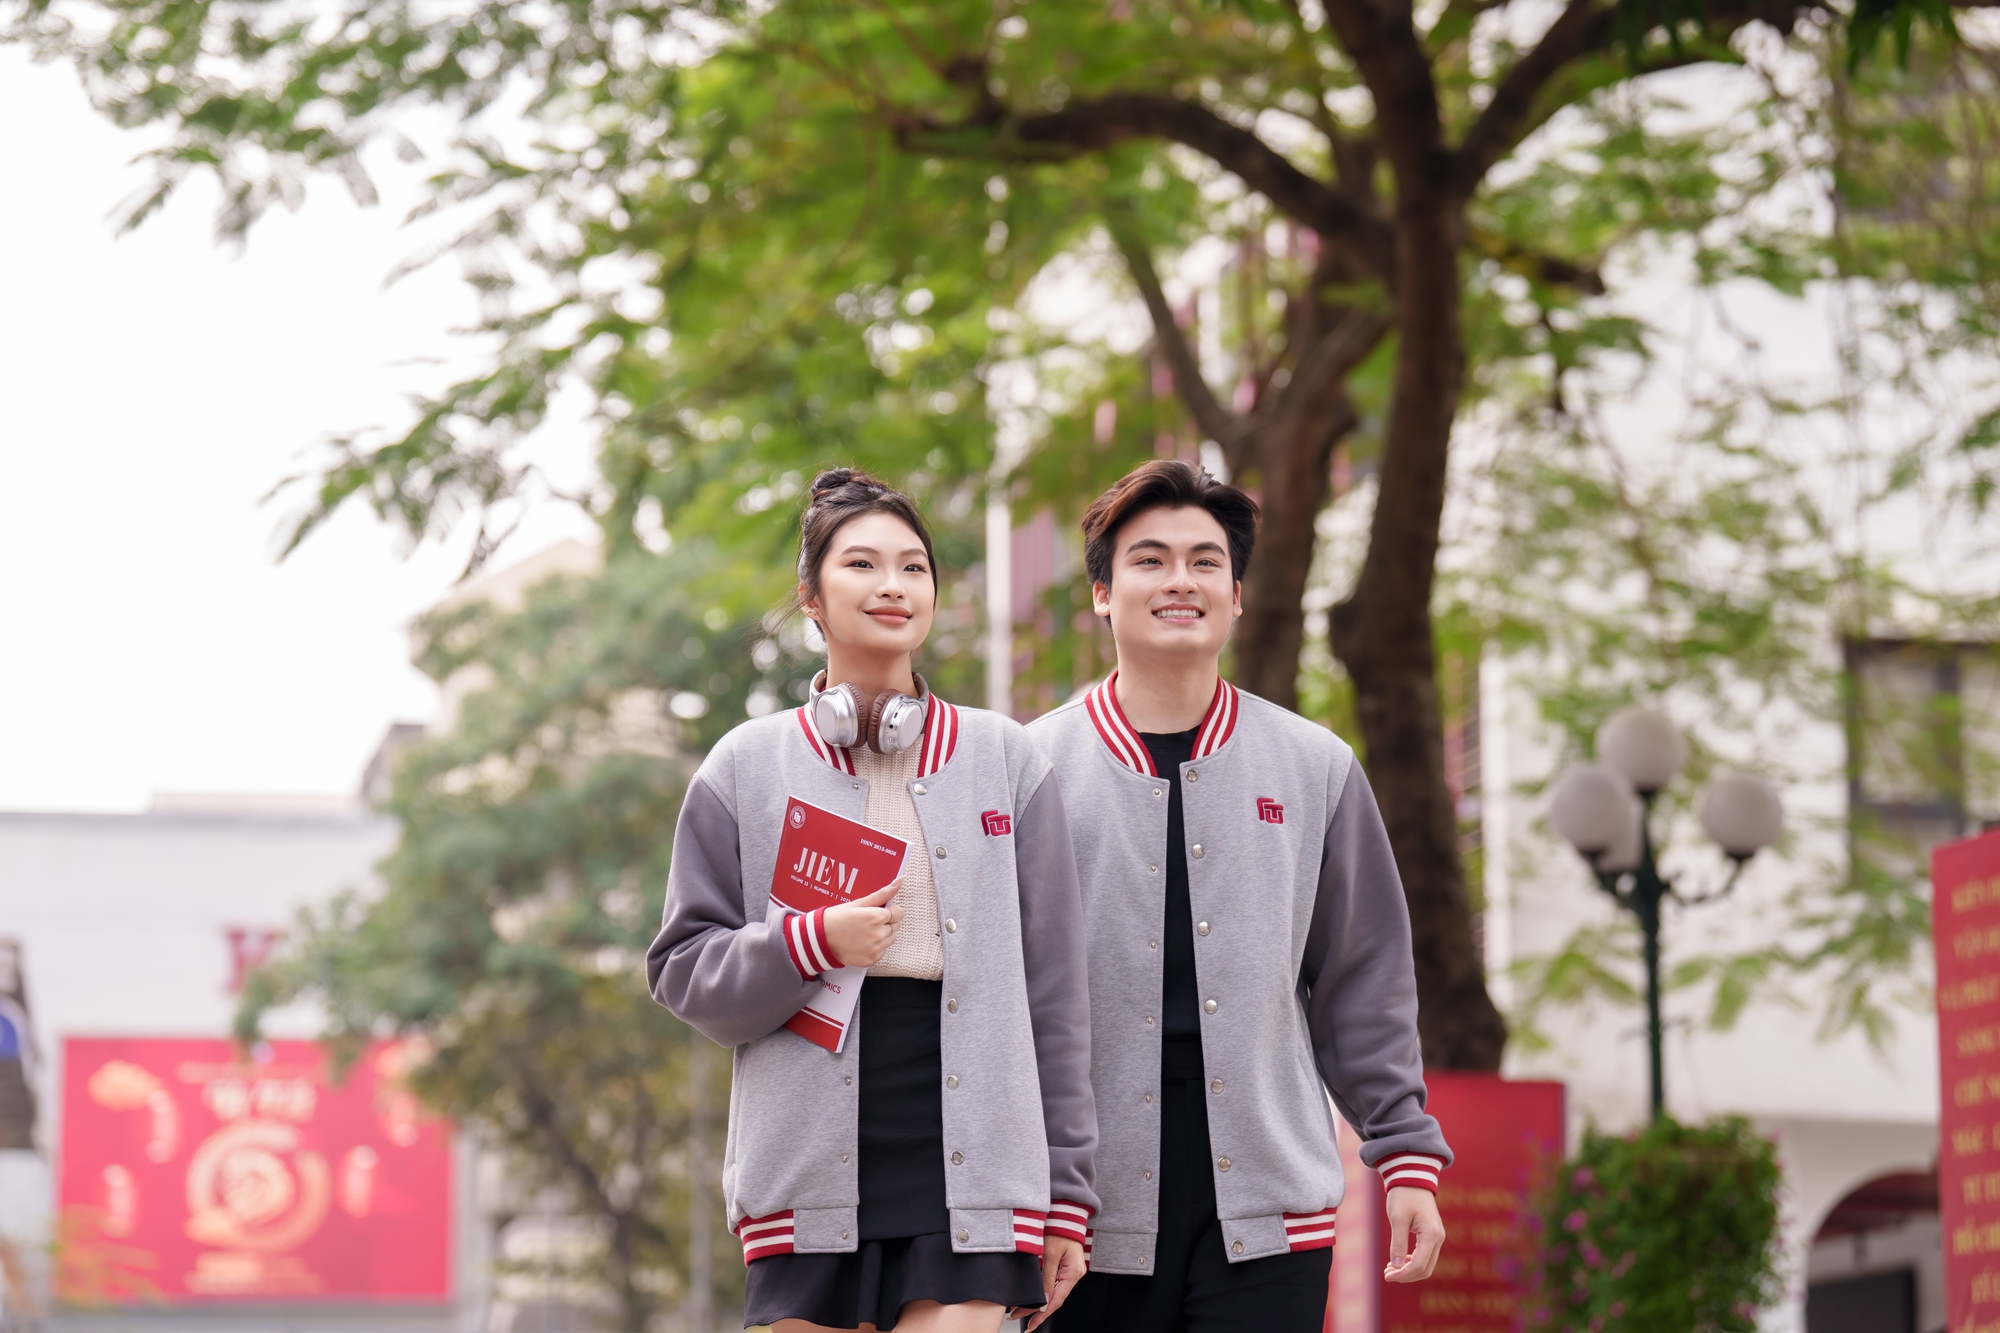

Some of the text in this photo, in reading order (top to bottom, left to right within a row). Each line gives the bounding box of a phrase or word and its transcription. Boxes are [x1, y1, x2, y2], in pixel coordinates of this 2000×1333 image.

[790, 874, 804, 885] VOLUME
[813, 885, 830, 896] NUMBER
[793, 847, 859, 894] JIEM
